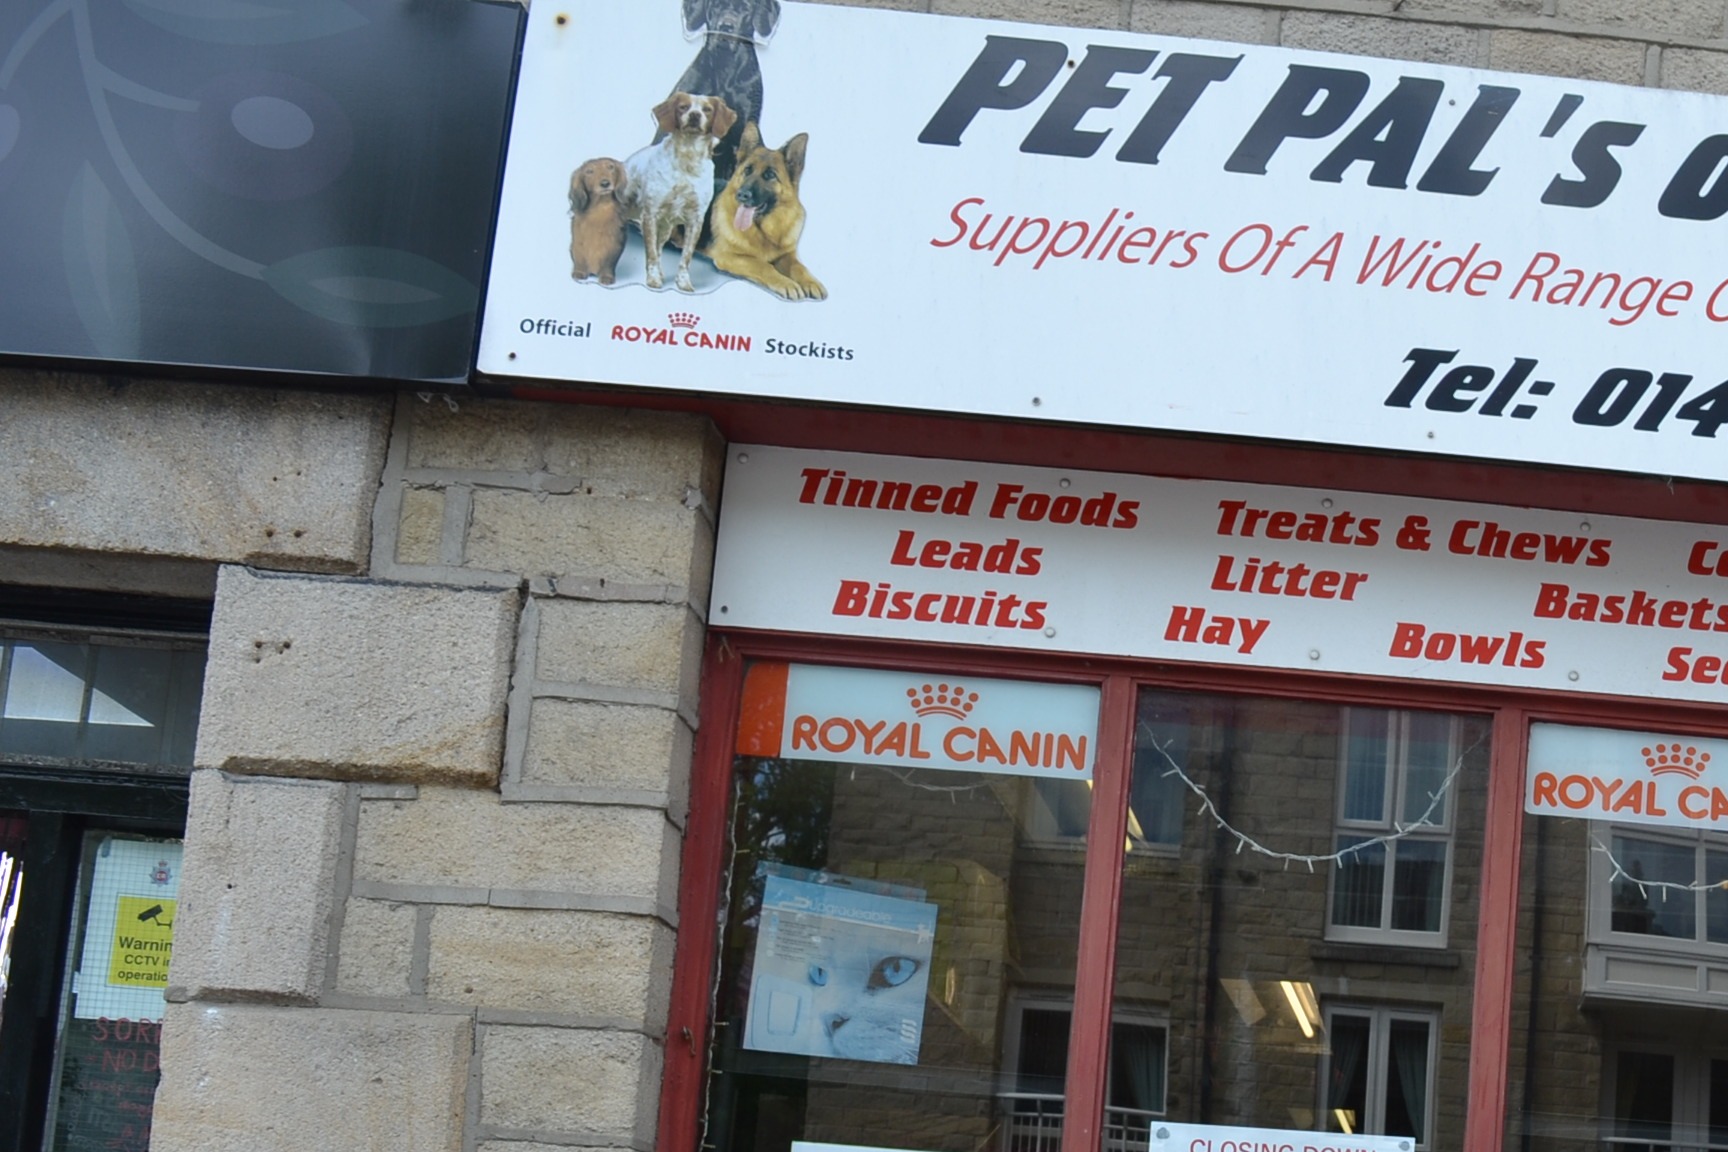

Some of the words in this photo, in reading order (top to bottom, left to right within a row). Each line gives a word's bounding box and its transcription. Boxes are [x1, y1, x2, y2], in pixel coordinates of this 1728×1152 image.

[917, 35, 1245, 166] PET
[1223, 62, 1647, 209] PAL's
[930, 197, 1211, 271] Suppliers
[1217, 223, 1313, 277] Of
[1294, 231, 1337, 282] A
[1355, 235, 1502, 297] Wide
[1509, 251, 1693, 327] Range
[519, 317, 591, 339] Official
[611, 324, 679, 346] ROYAL
[684, 331, 752, 353] CANIN
[764, 338, 855, 361] Stockists
[1383, 347, 1556, 419] Tel:
[799, 468, 978, 516] Tinned
[989, 483, 1141, 529] Foods
[890, 530, 1044, 576] Leads
[1217, 500, 1380, 547] Treats
[1396, 515, 1432, 551] &
[1448, 519, 1611, 567] Chews
[1211, 555, 1368, 601] Litter
[832, 579, 1048, 630] Biscuits
[1163, 606, 1270, 655] Hay
[1389, 622, 1547, 669] Bowls
[792, 715, 930, 759] ROYAL
[943, 726, 1087, 771] CANIN
[1533, 771, 1666, 817] ROYAL
[119, 936, 173, 952] Warnin
[124, 955, 159, 966] CCTV
[118, 970, 168, 982] operatio
[93, 1017, 162, 1045] SORR
[102, 1050, 135, 1072] NO
